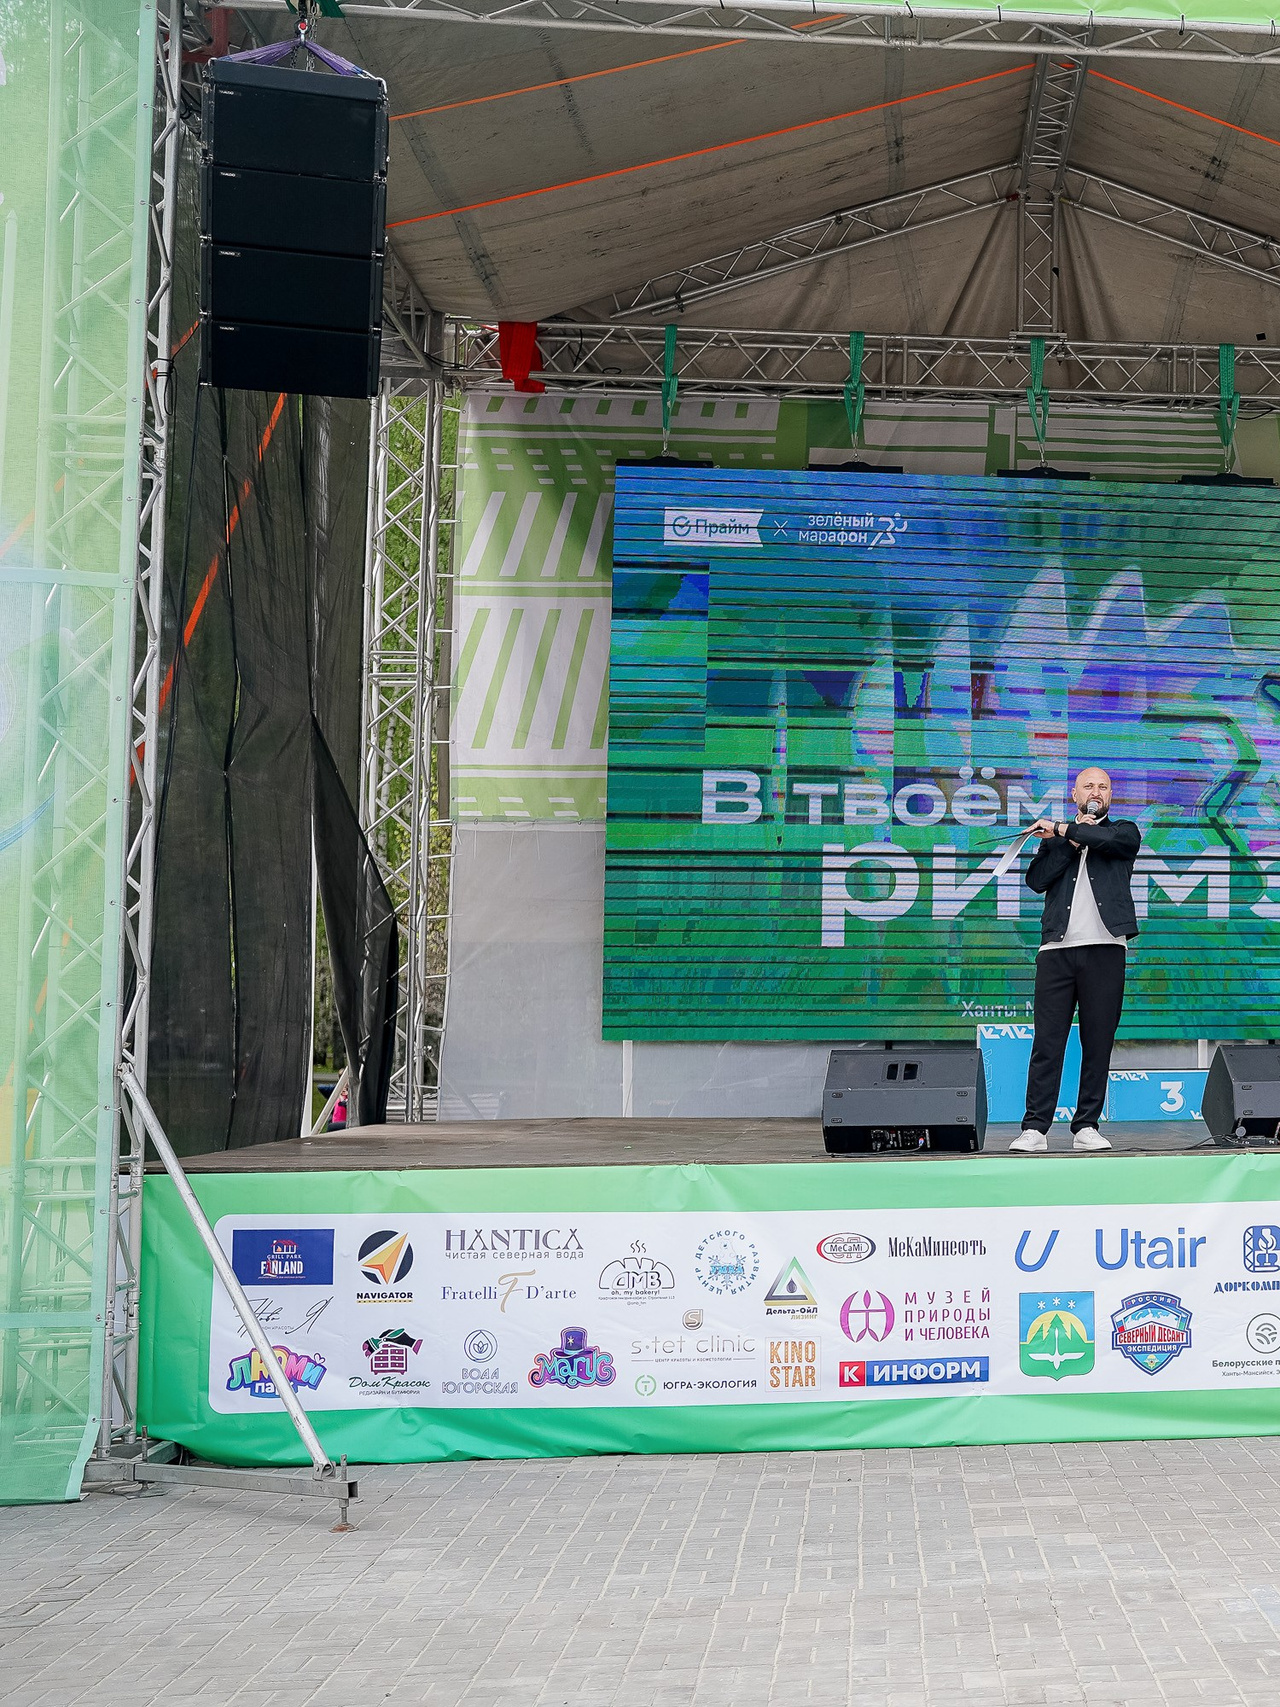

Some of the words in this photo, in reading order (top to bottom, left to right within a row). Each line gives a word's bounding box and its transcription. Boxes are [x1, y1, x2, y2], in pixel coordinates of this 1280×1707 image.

[694, 518, 751, 535] Прайм
[807, 511, 875, 528] зелёный
[798, 529, 868, 545] марафон
[702, 769, 763, 825] В
[792, 766, 1066, 827] твоём
[1160, 1081, 1186, 1114] 3
[445, 1228, 584, 1251] HANTICA
[829, 1243, 863, 1252] MeCaMi
[888, 1236, 987, 1258] МеКаМинефть
[445, 1251, 486, 1260] чистая
[492, 1251, 550, 1261] северная
[556, 1251, 584, 1260] вода
[1095, 1227, 1207, 1271] Utair
[260, 1260, 304, 1276] FINLAND
[356, 1292, 413, 1300] NAVIGATOR
[441, 1286, 498, 1300] Fratelli
[525, 1285, 577, 1300] D’arte
[904, 1288, 991, 1305] МУЗЕЙ
[1131, 1295, 1172, 1305] РОССИЯ
[904, 1308, 991, 1323] ПРИРОДЫ
[904, 1328, 914, 1341] И
[919, 1326, 990, 1341] ЧЕЛОВЕКА
[1118, 1323, 1157, 1344] СЕВЕРНЫЙ
[1157, 1326, 1185, 1343] ДЕСАНТ
[696, 1334, 756, 1354] clinic
[770, 1340, 816, 1364] KINO
[1127, 1345, 1178, 1353] ЭКСПЕДИЦИЯ
[844, 1365, 860, 1383] К
[873, 1361, 981, 1382] ИНФОРМ
[1212, 1359, 1274, 1369] Белорусские
[461, 1368, 500, 1380] ВОДА
[769, 1365, 816, 1388] STAR
[348, 1376, 382, 1388] Дом
[380, 1376, 432, 1390] Красок
[441, 1382, 518, 1395] ЮГОРСКАЯ
[663, 1379, 757, 1390] ЮГРА-ЭКОЛОГИЯ
